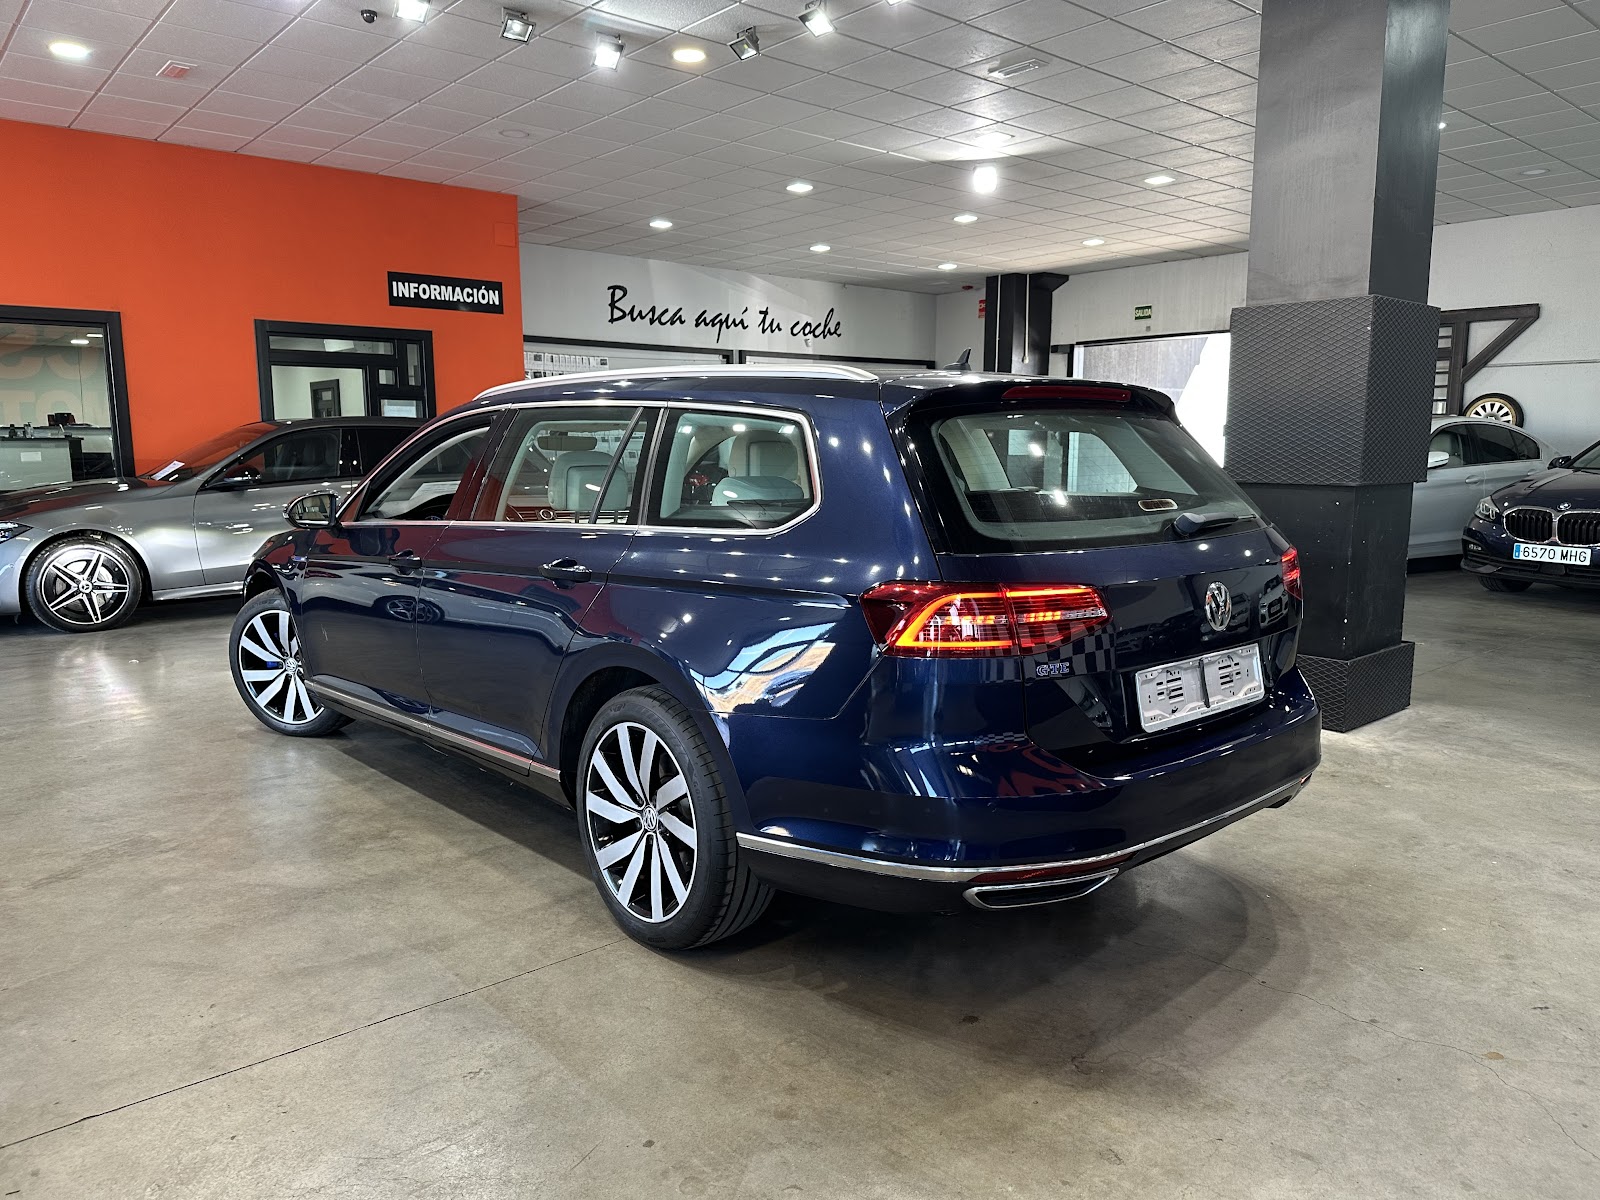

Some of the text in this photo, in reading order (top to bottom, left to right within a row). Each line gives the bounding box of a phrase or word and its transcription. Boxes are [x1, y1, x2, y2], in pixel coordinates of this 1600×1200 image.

[392, 281, 500, 306] INFORMACIÓN
[607, 284, 842, 344] Busca aquí tu coche
[1522, 546, 1588, 563] 6570 MHG
[1036, 661, 1070, 677] GTE
